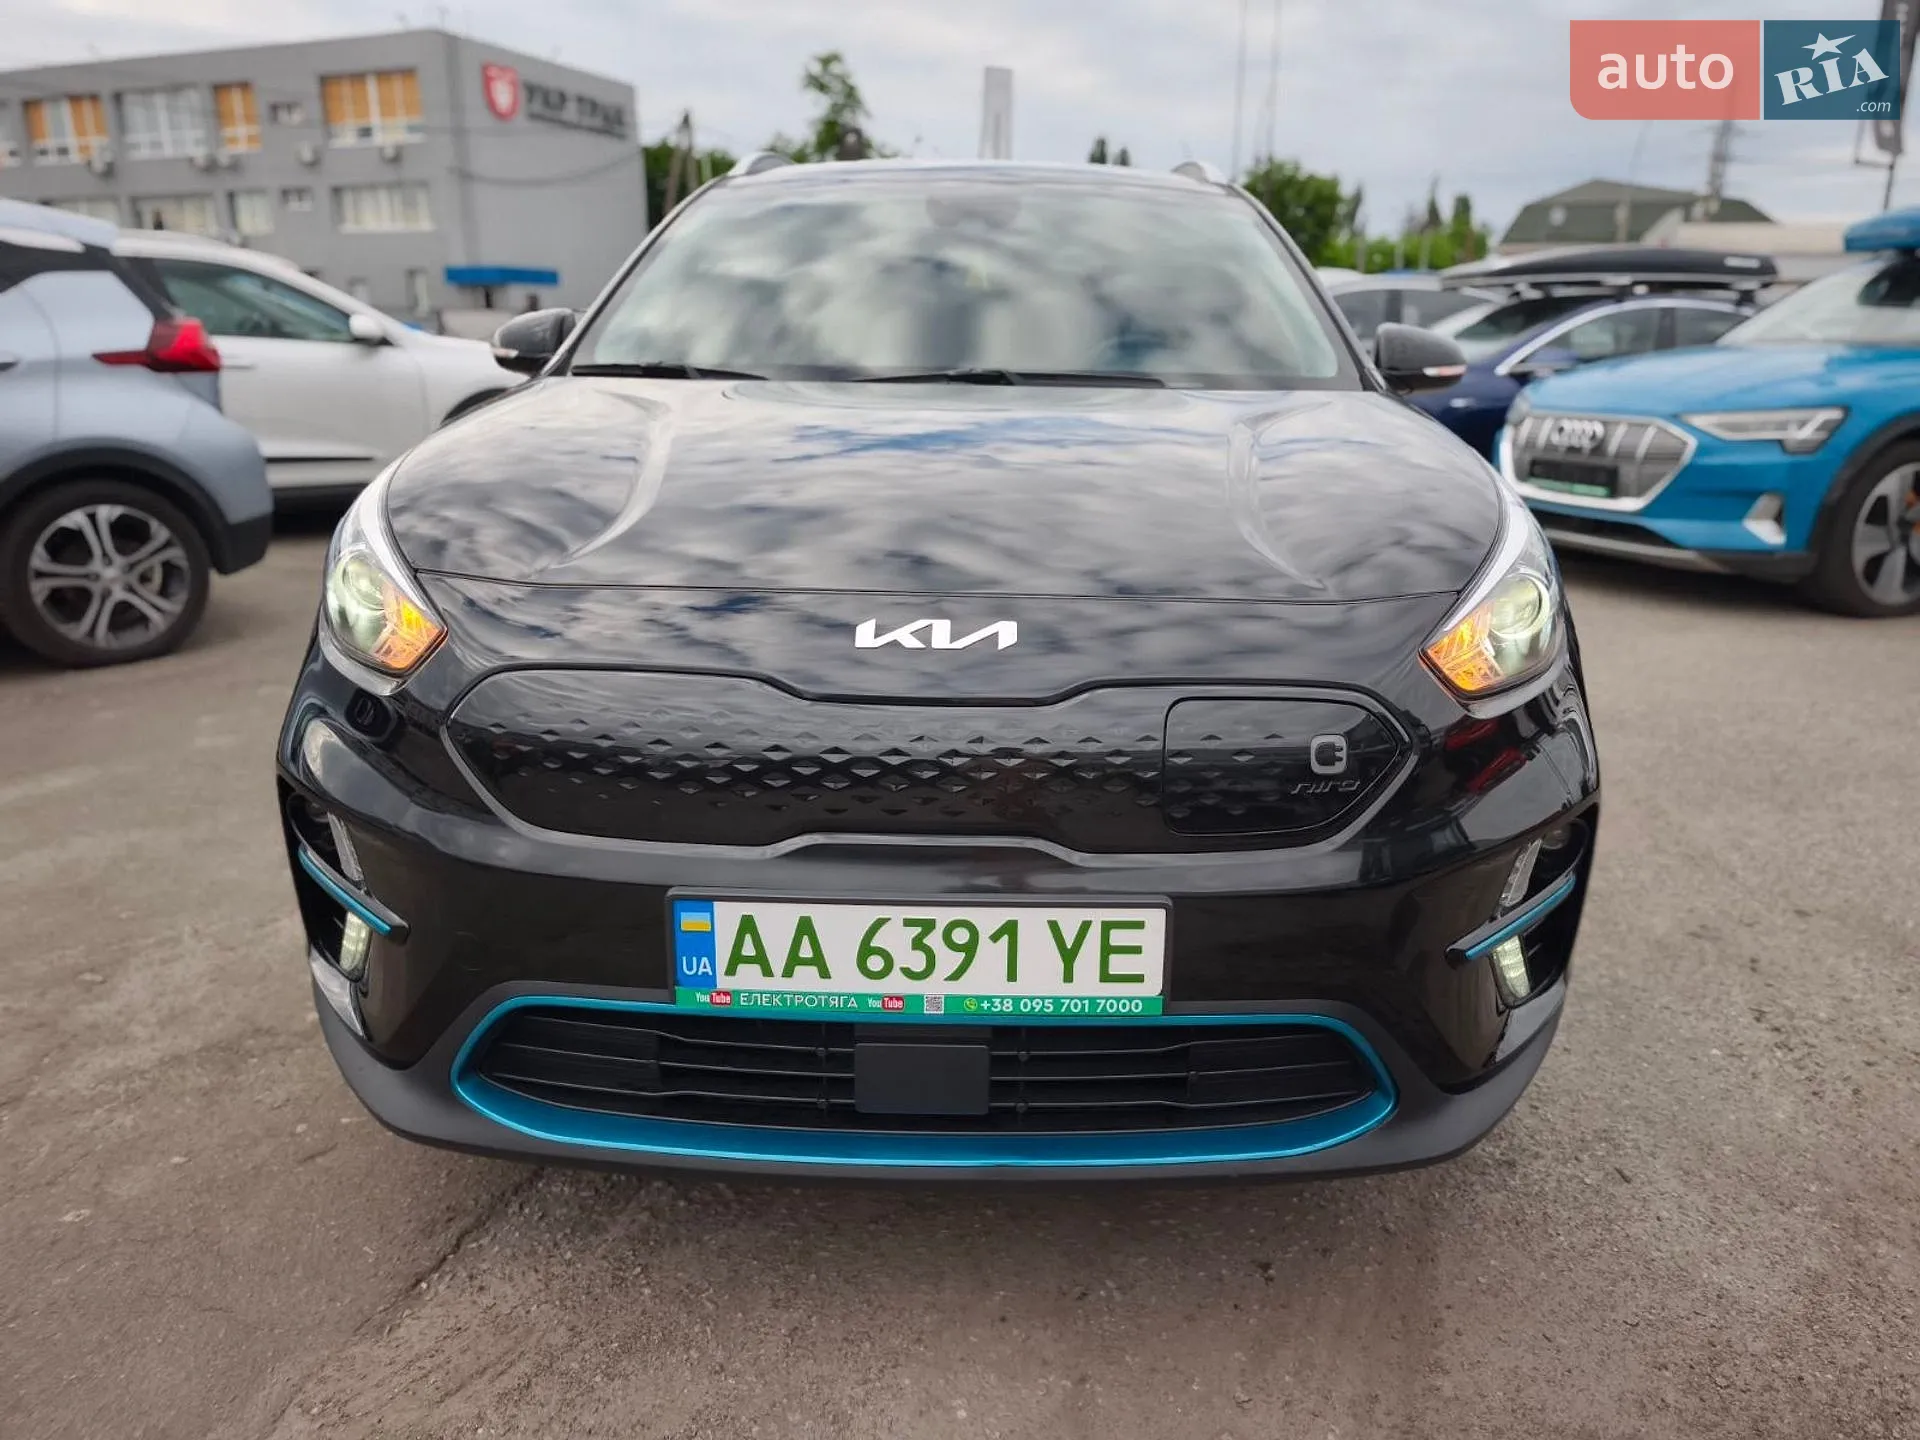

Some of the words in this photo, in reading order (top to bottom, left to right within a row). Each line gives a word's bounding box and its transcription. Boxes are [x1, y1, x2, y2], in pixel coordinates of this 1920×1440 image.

[855, 618, 1018, 650] KIA
[724, 914, 832, 979] AA
[856, 917, 1019, 983] 6391
[1047, 919, 1146, 983] YE
[682, 956, 713, 975] UA
[740, 993, 858, 1008] ЕЛЕКТРОТЯГА
[980, 998, 1013, 1012] +38
[1020, 998, 1054, 1013] 095
[1060, 998, 1090, 1013] 701
[1096, 999, 1143, 1013] 7000
